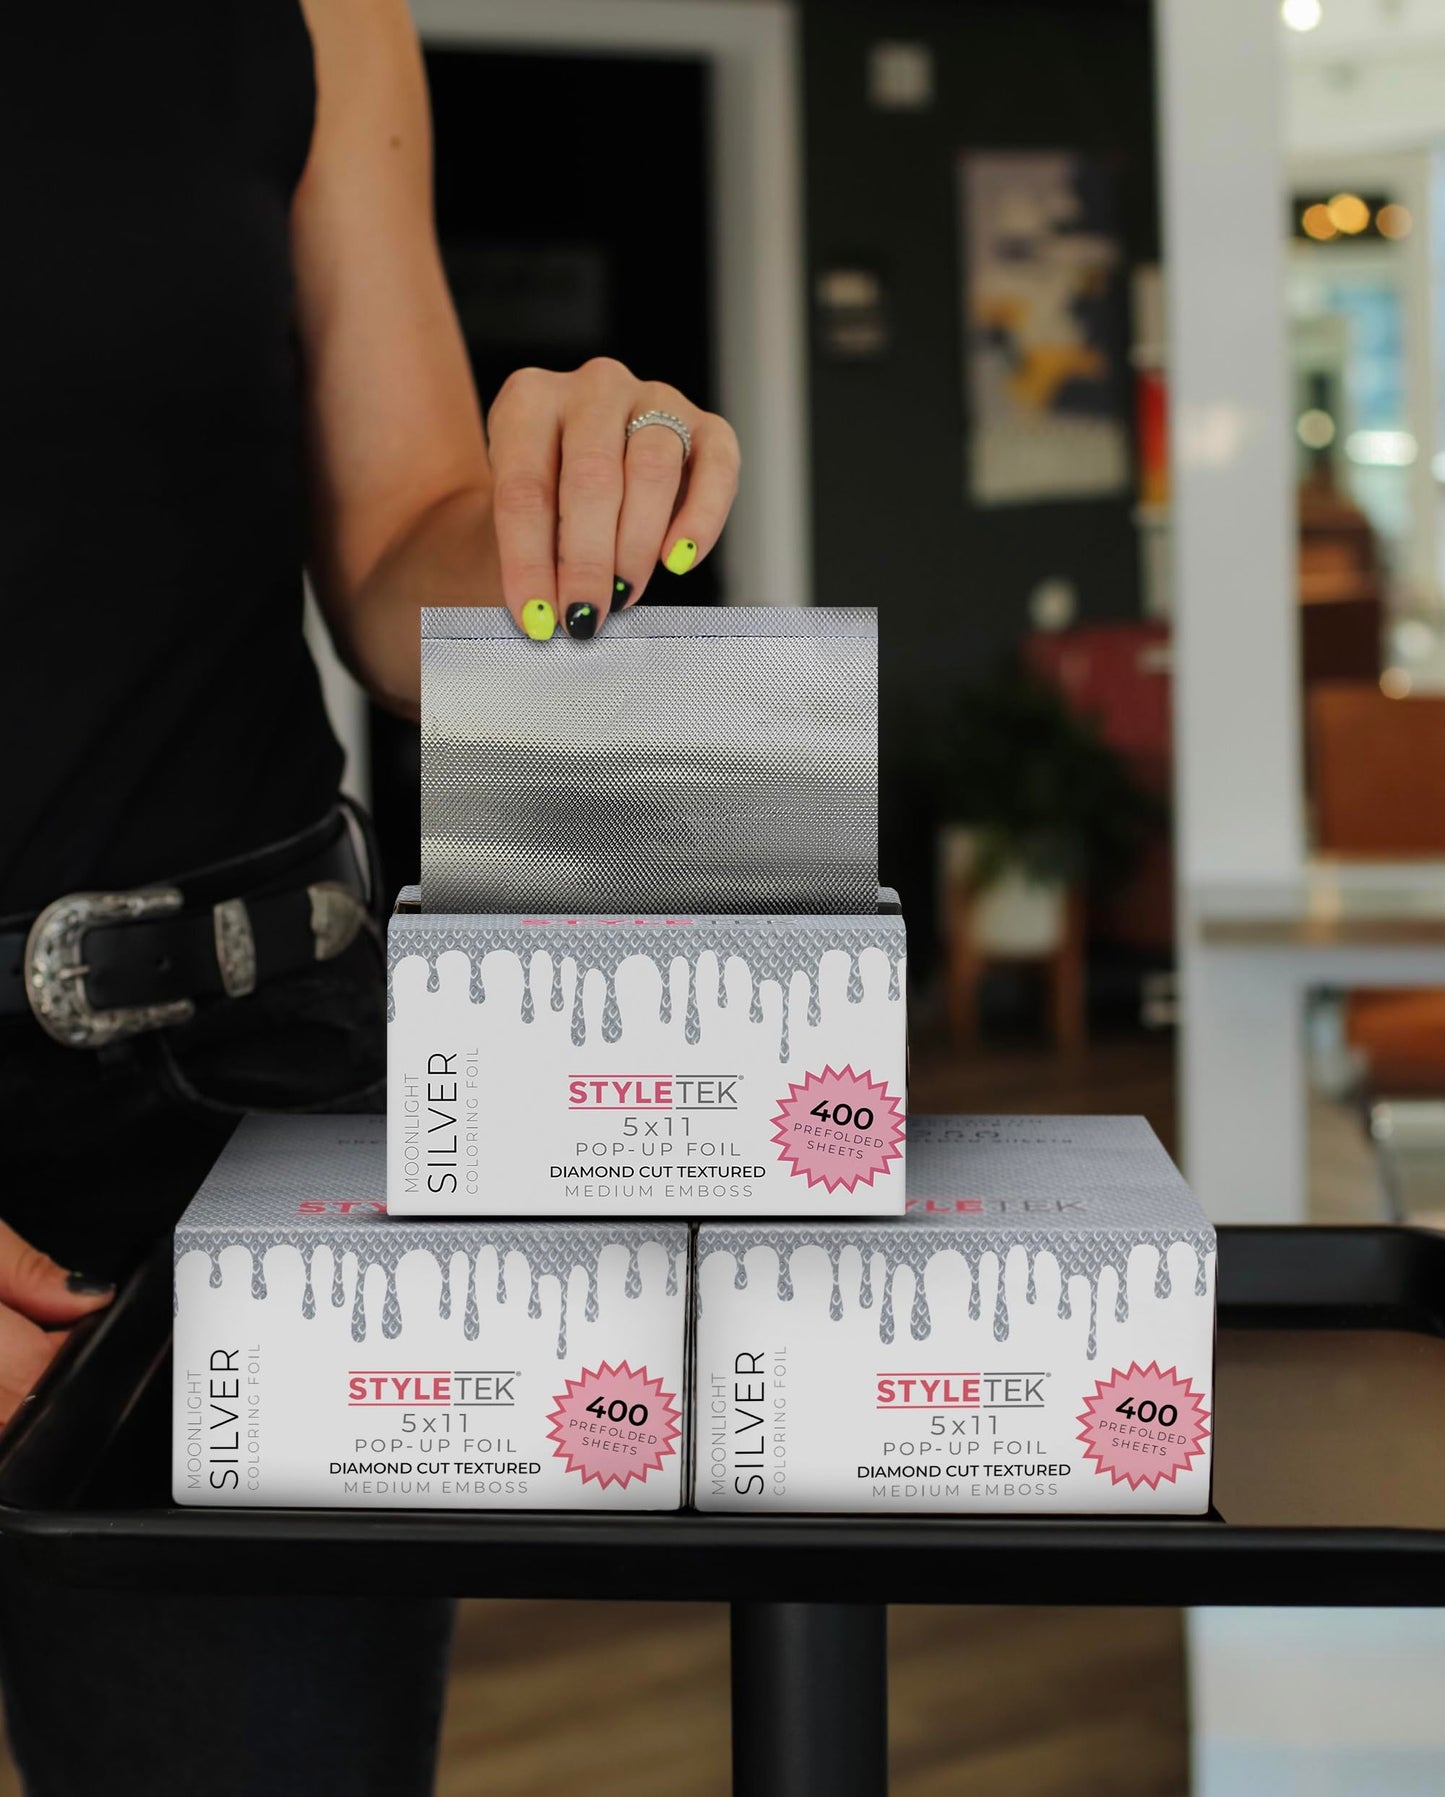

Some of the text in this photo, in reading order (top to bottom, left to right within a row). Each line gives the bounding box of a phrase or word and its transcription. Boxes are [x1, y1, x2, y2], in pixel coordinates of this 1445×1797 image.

[427, 1053, 457, 1193] SILVER
[464, 1048, 480, 1194] COLORING FOIL
[623, 1117, 689, 1136] 5x11
[810, 1099, 875, 1131] 400
[403, 1073, 419, 1192] MOONLIGHT
[793, 1122, 885, 1149] PREFOLDED
[577, 1142, 741, 1157] POP-UP FOIL
[806, 1139, 865, 1160] SHEETS
[550, 1166, 766, 1178] DIAMOND CUT TEXTURED
[566, 1185, 752, 1197] MEDIUM EMBOSS
[209, 1350, 239, 1489] SILVER
[248, 1344, 260, 1490] COLORING FOIL
[585, 1395, 650, 1427] 400
[773, 1347, 786, 1496] COLORING FOIL
[1115, 1397, 1178, 1427] 400
[187, 1370, 202, 1488] MOONLIGHT
[402, 1414, 466, 1433] 5x11
[569, 1418, 659, 1445] PREFOLDED
[711, 1373, 726, 1494] MOONLIGHT
[734, 1352, 765, 1495] SILVER
[931, 1415, 996, 1435] 5x11
[1098, 1419, 1188, 1446] PREFOLDED
[356, 1439, 517, 1454] POP-UP FOIL
[581, 1435, 639, 1456] SHEETS
[884, 1440, 1047, 1456] POP-UP FOIL
[1111, 1437, 1169, 1457] SHEETS
[330, 1462, 541, 1474] DIAMOND CUT TEXTURED
[858, 1464, 1071, 1478] DIAMOND CUT TEXTURED
[345, 1481, 527, 1493] MEDIUM EMBOSS
[873, 1484, 1057, 1497] MEDIUM EMBOSS
